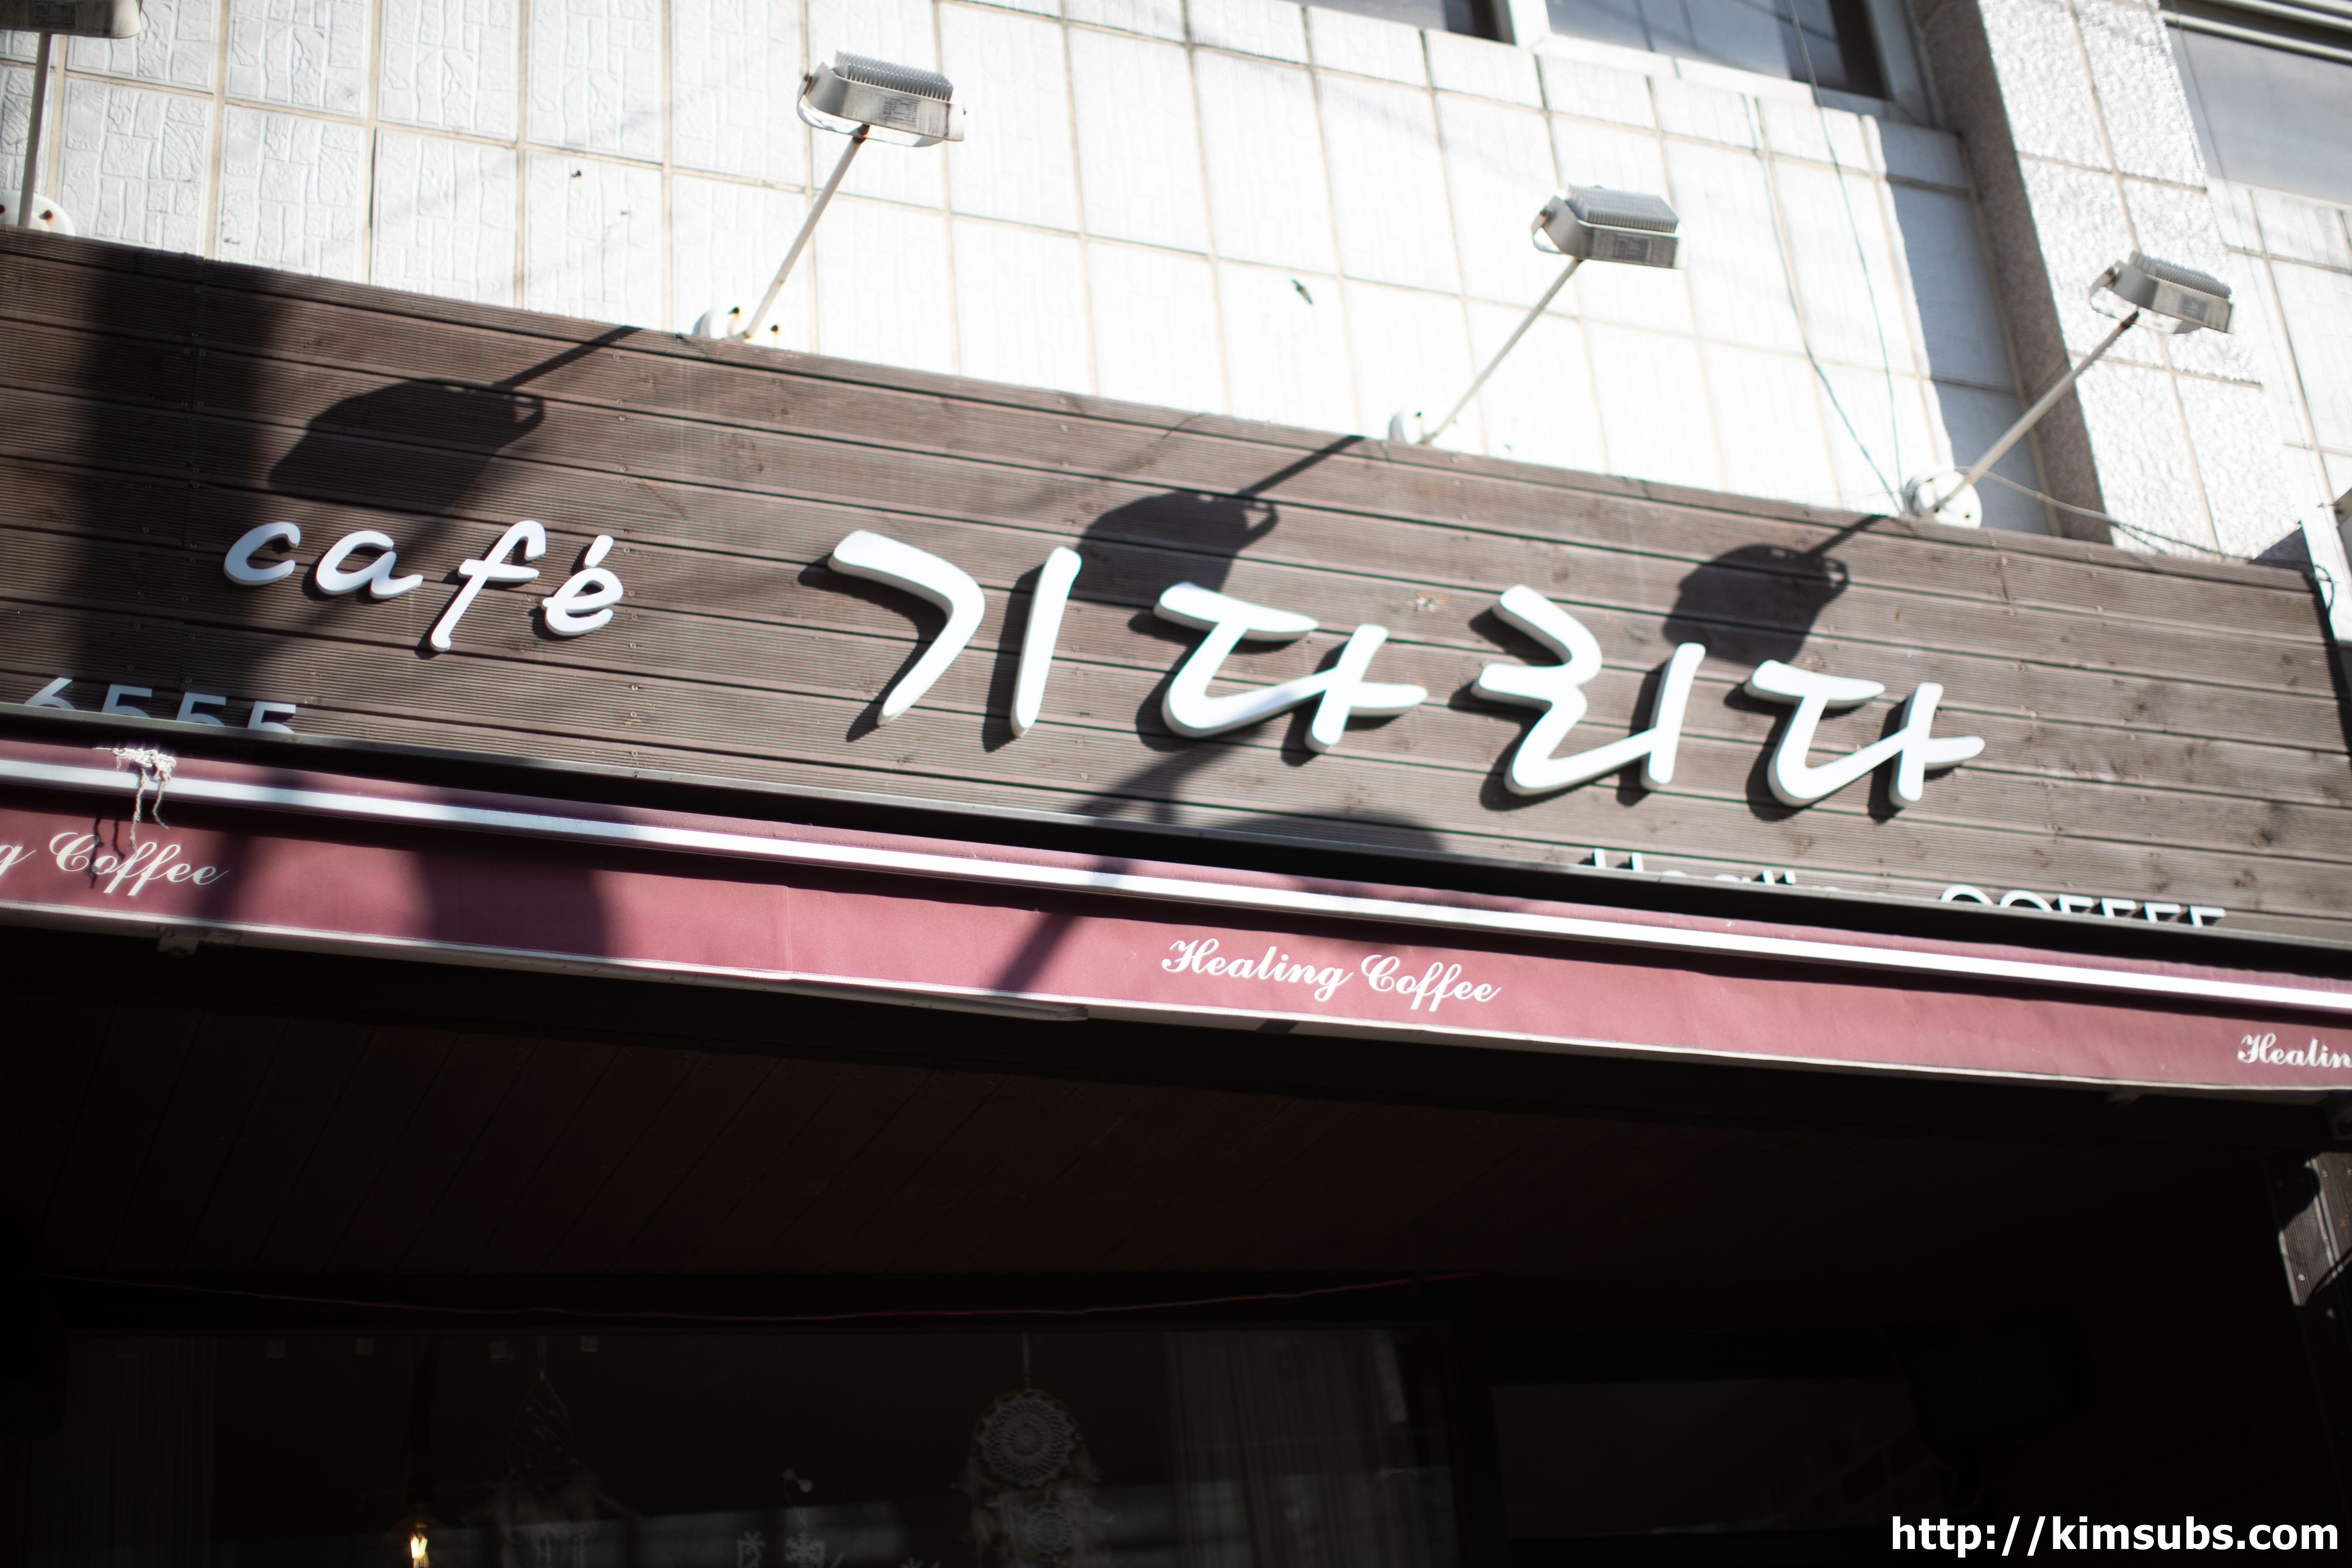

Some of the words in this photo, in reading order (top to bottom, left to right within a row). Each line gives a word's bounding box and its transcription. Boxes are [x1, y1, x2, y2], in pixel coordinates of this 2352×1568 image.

[224, 520, 624, 652] café
[827, 530, 1986, 810] 기다리다
[49, 832, 229, 897] Coffee
[1161, 938, 1354, 1002] Healing
[1361, 954, 1501, 1012] Coffee
